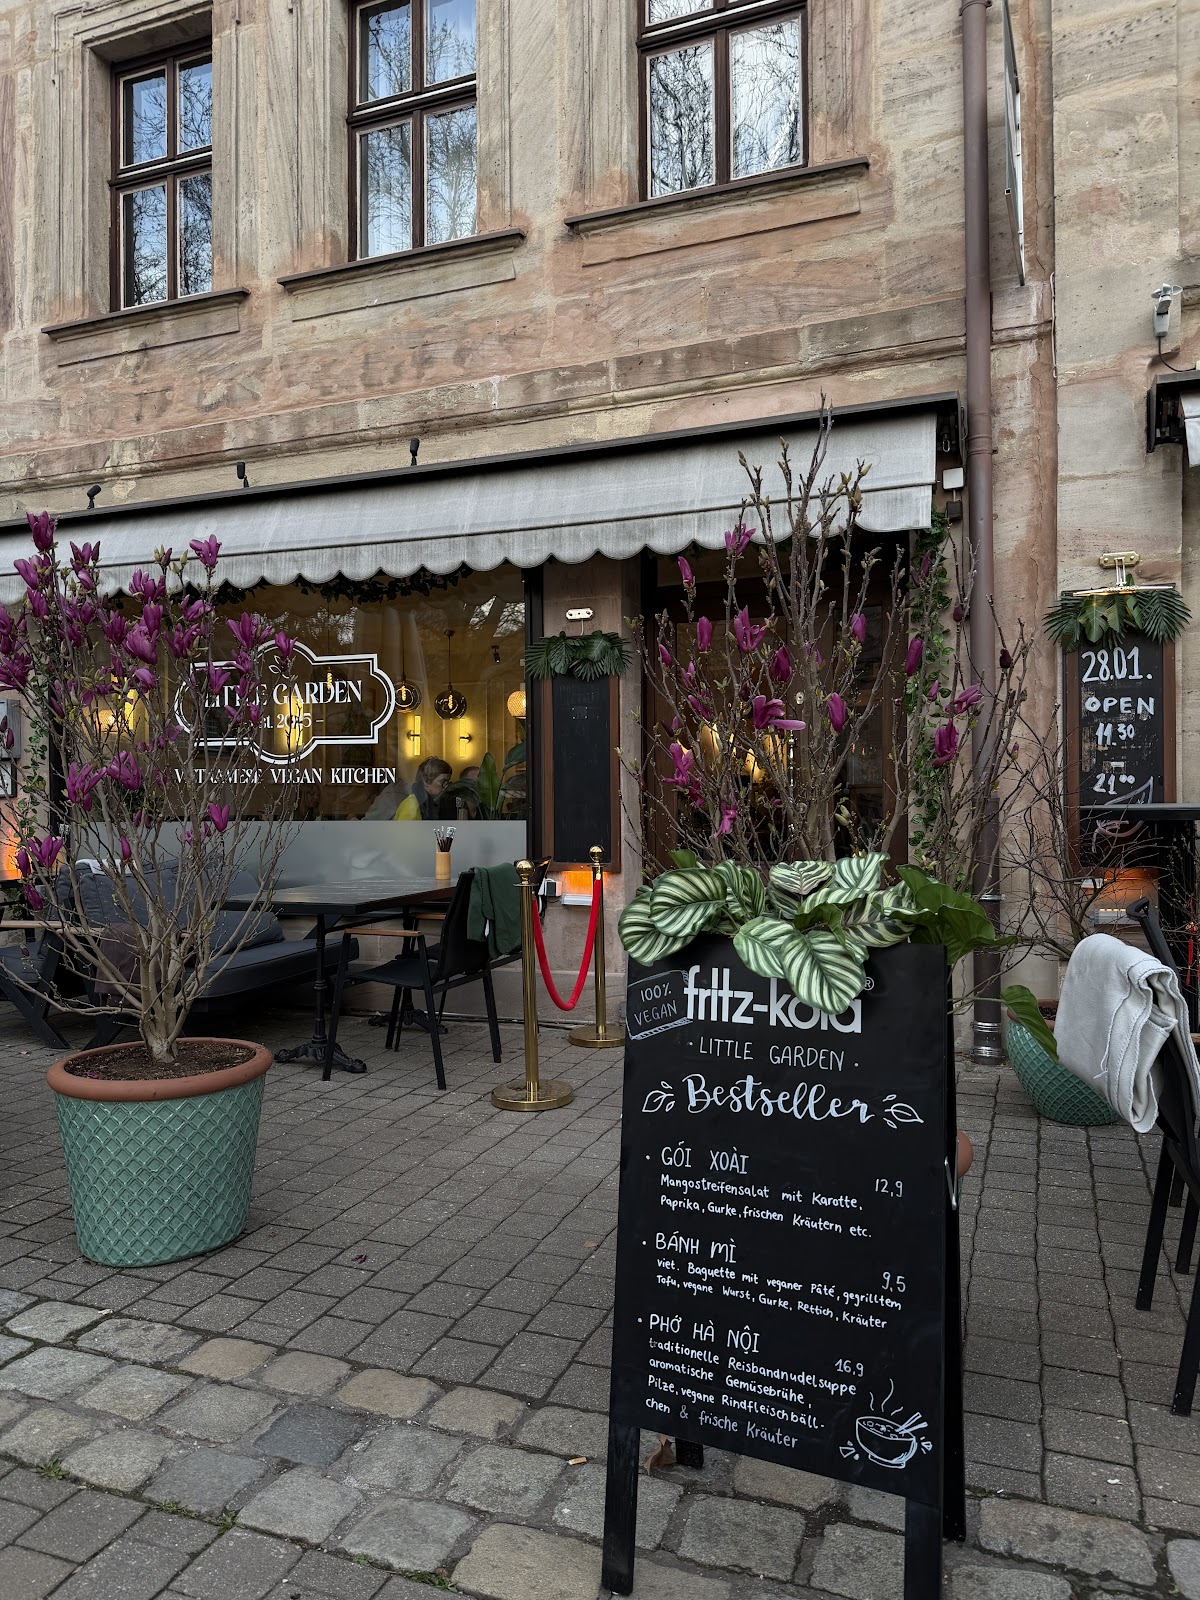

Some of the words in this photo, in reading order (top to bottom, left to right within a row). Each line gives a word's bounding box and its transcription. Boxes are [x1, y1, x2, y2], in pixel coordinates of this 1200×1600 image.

[272, 679, 362, 706] GARDEN
[1084, 696, 1155, 716] OPEN
[331, 767, 396, 784] KITCHEN
[640, 981, 672, 1003] 100%
[633, 999, 678, 1026] VEGAN
[699, 1036, 754, 1061] LITTLE
[769, 1045, 844, 1072] GARDEN
[681, 1073, 876, 1124] Bestseller
[709, 1146, 750, 1175] XOÀI
[660, 1173, 770, 1199] Mangostreifensalat
[781, 1189, 803, 1203] mit
[875, 1178, 903, 1198] 12,9
[660, 1194, 705, 1214] Paprika,
[707, 1201, 742, 1219] Gurke,
[742, 1205, 784, 1222] frischen
[792, 1213, 843, 1234] Kräutern
[849, 1225, 872, 1238] etc.
[655, 1230, 700, 1255] BÁNH
[656, 1257, 680, 1271] viet.
[687, 1261, 736, 1282] Baguette
[741, 1272, 759, 1285] mit
[766, 1278, 803, 1293] veganer
[810, 1283, 840, 1302] Pâté,
[842, 1291, 902, 1311] gegrilltem
[656, 1274, 681, 1289] Tofu,
[682, 1281, 714, 1296] vegane
[722, 1285, 755, 1303] Wurst,
[758, 1293, 793, 1311] Gurke,
[797, 1300, 839, 1322] Rettich,
[842, 1310, 888, 1329] Kräuter
[692, 1319, 715, 1343] HÀ
[726, 1324, 760, 1354] NỘI
[648, 1337, 720, 1366] traditionelle
[727, 1356, 857, 1396] Reisbandnudelsuppe
[648, 1357, 714, 1382] aromatische
[724, 1374, 813, 1409] Gemüsebrühe,
[648, 1374, 679, 1396] Pilze,
[680, 1387, 715, 1404] vegane
[721, 1393, 825, 1430] Rindfleischbäll-
[645, 1397, 671, 1414] chen
[679, 1404, 689, 1420] &
[698, 1410, 739, 1433] frische
[746, 1421, 799, 1450] Kräuter
